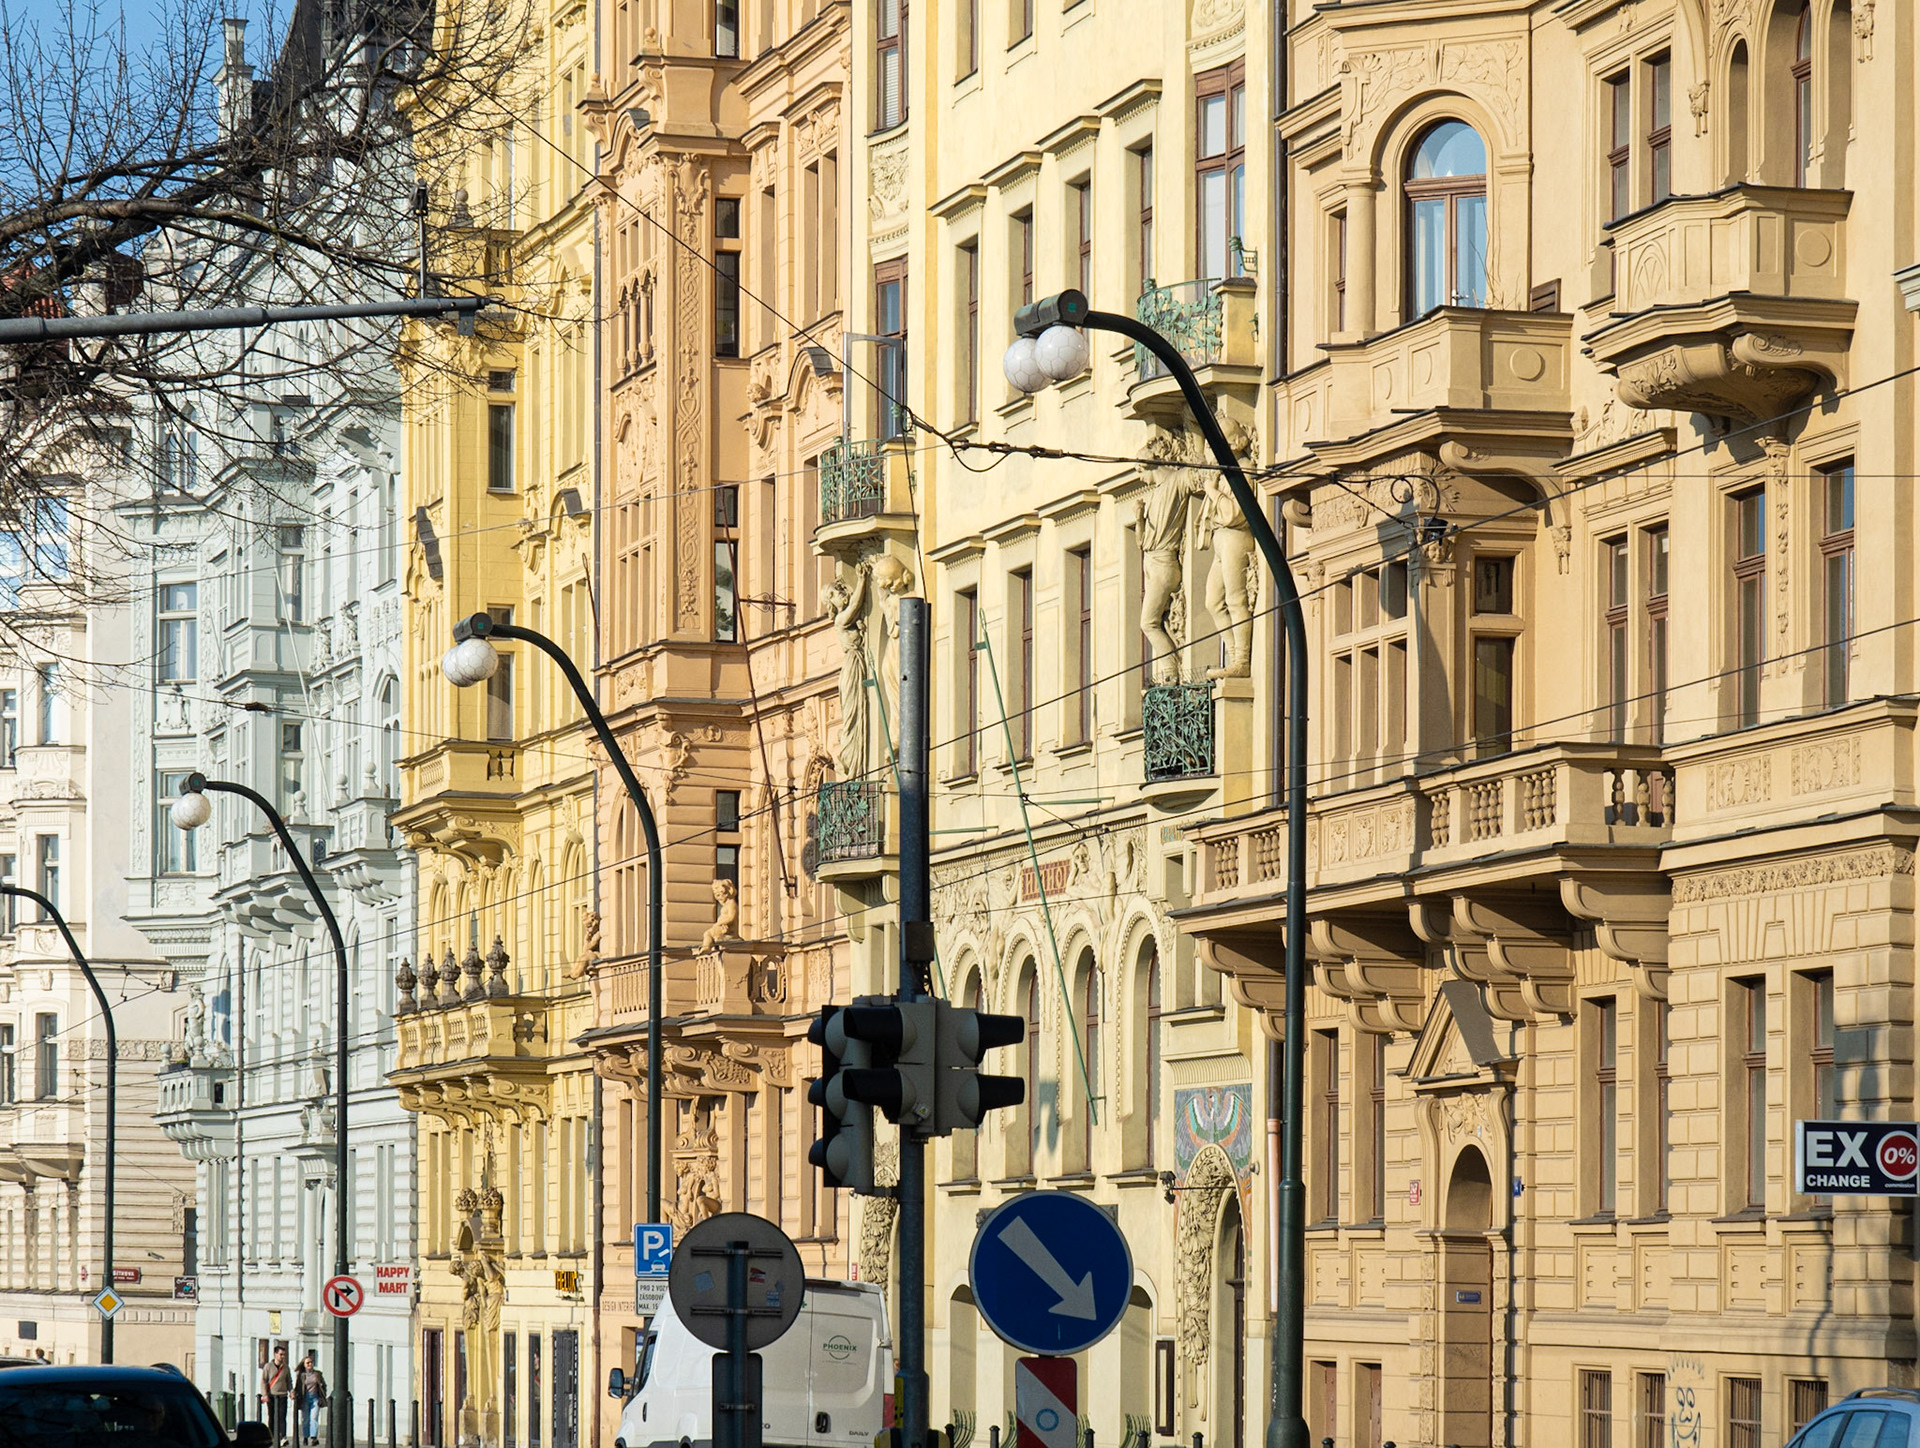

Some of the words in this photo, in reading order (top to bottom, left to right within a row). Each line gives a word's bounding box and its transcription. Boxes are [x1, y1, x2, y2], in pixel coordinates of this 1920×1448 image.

[1806, 1131, 1869, 1168] EX
[1884, 1147, 1916, 1164] 0%
[1806, 1174, 1871, 1188] CHANGE
[643, 1231, 664, 1260] P
[376, 1266, 410, 1278] HAPPY
[378, 1282, 408, 1293] MART
[823, 1343, 857, 1352] PHOENIX
